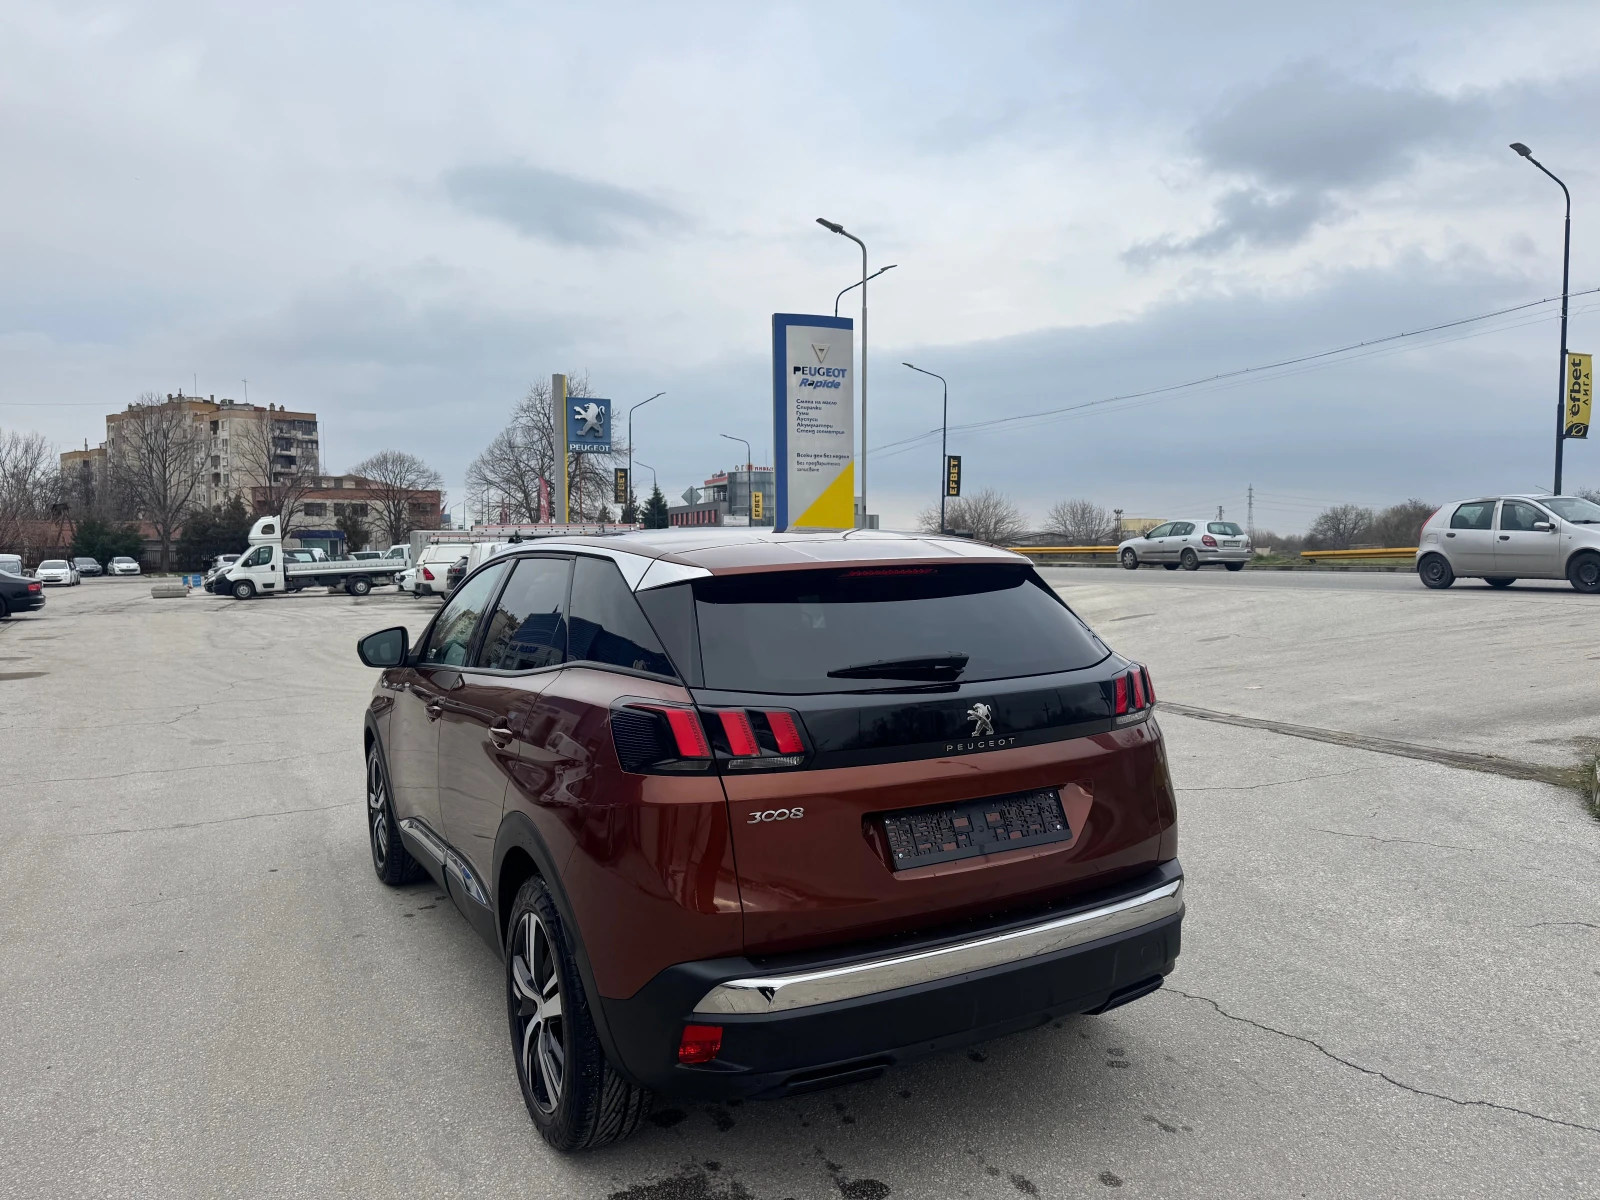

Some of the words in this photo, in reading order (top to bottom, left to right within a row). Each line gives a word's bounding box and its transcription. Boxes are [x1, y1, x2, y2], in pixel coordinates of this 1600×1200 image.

[793, 366, 848, 378] PEUGEOT
[799, 378, 842, 390] Rapide
[1570, 358, 1581, 416] efbet
[569, 443, 610, 452] PEUGEOT
[950, 458, 958, 494] EFBET
[946, 738, 1015, 752] PEUGEOT
[746, 807, 805, 825] 3008
